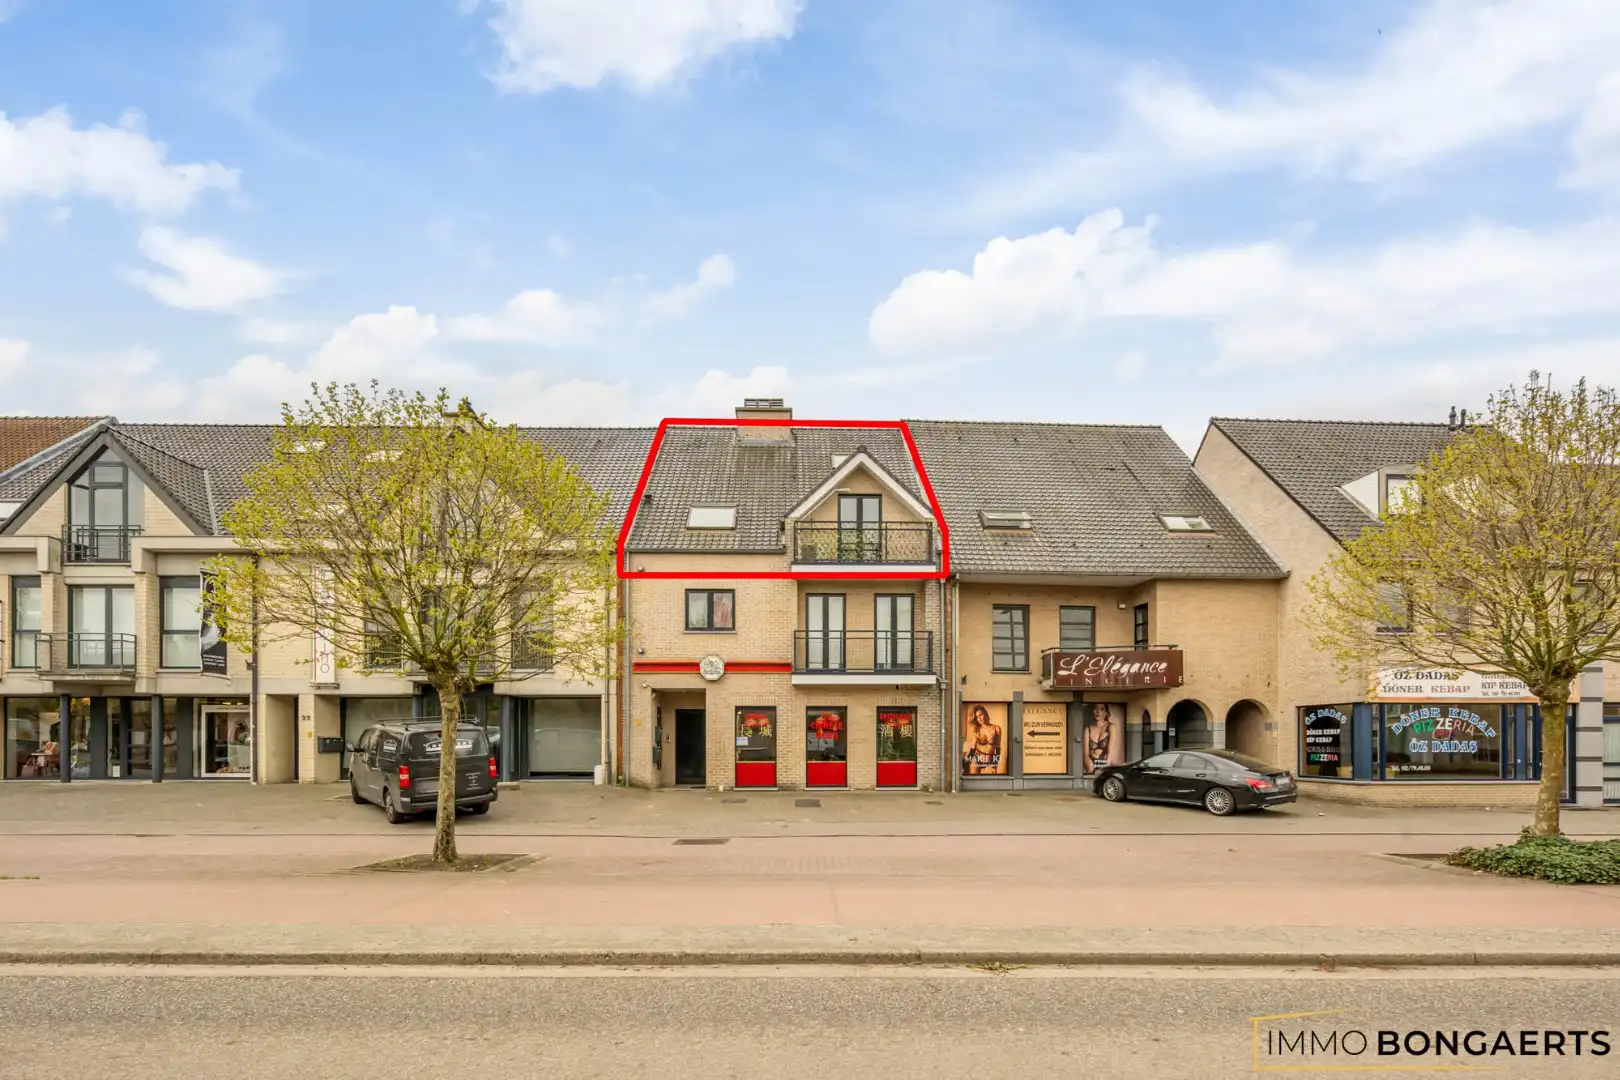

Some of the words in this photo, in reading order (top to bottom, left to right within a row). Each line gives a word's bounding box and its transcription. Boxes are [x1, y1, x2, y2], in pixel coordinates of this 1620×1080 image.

[1057, 654, 1168, 679] L'Elégance
[1382, 683, 1423, 693] DÖNER
[1431, 685, 1471, 693] KEBAP
[1391, 707, 1441, 735] DÖNER
[1448, 707, 1496, 738] KEBAP
[1413, 717, 1475, 736] PIZZERIA
[1409, 738, 1428, 752] ÖZ
